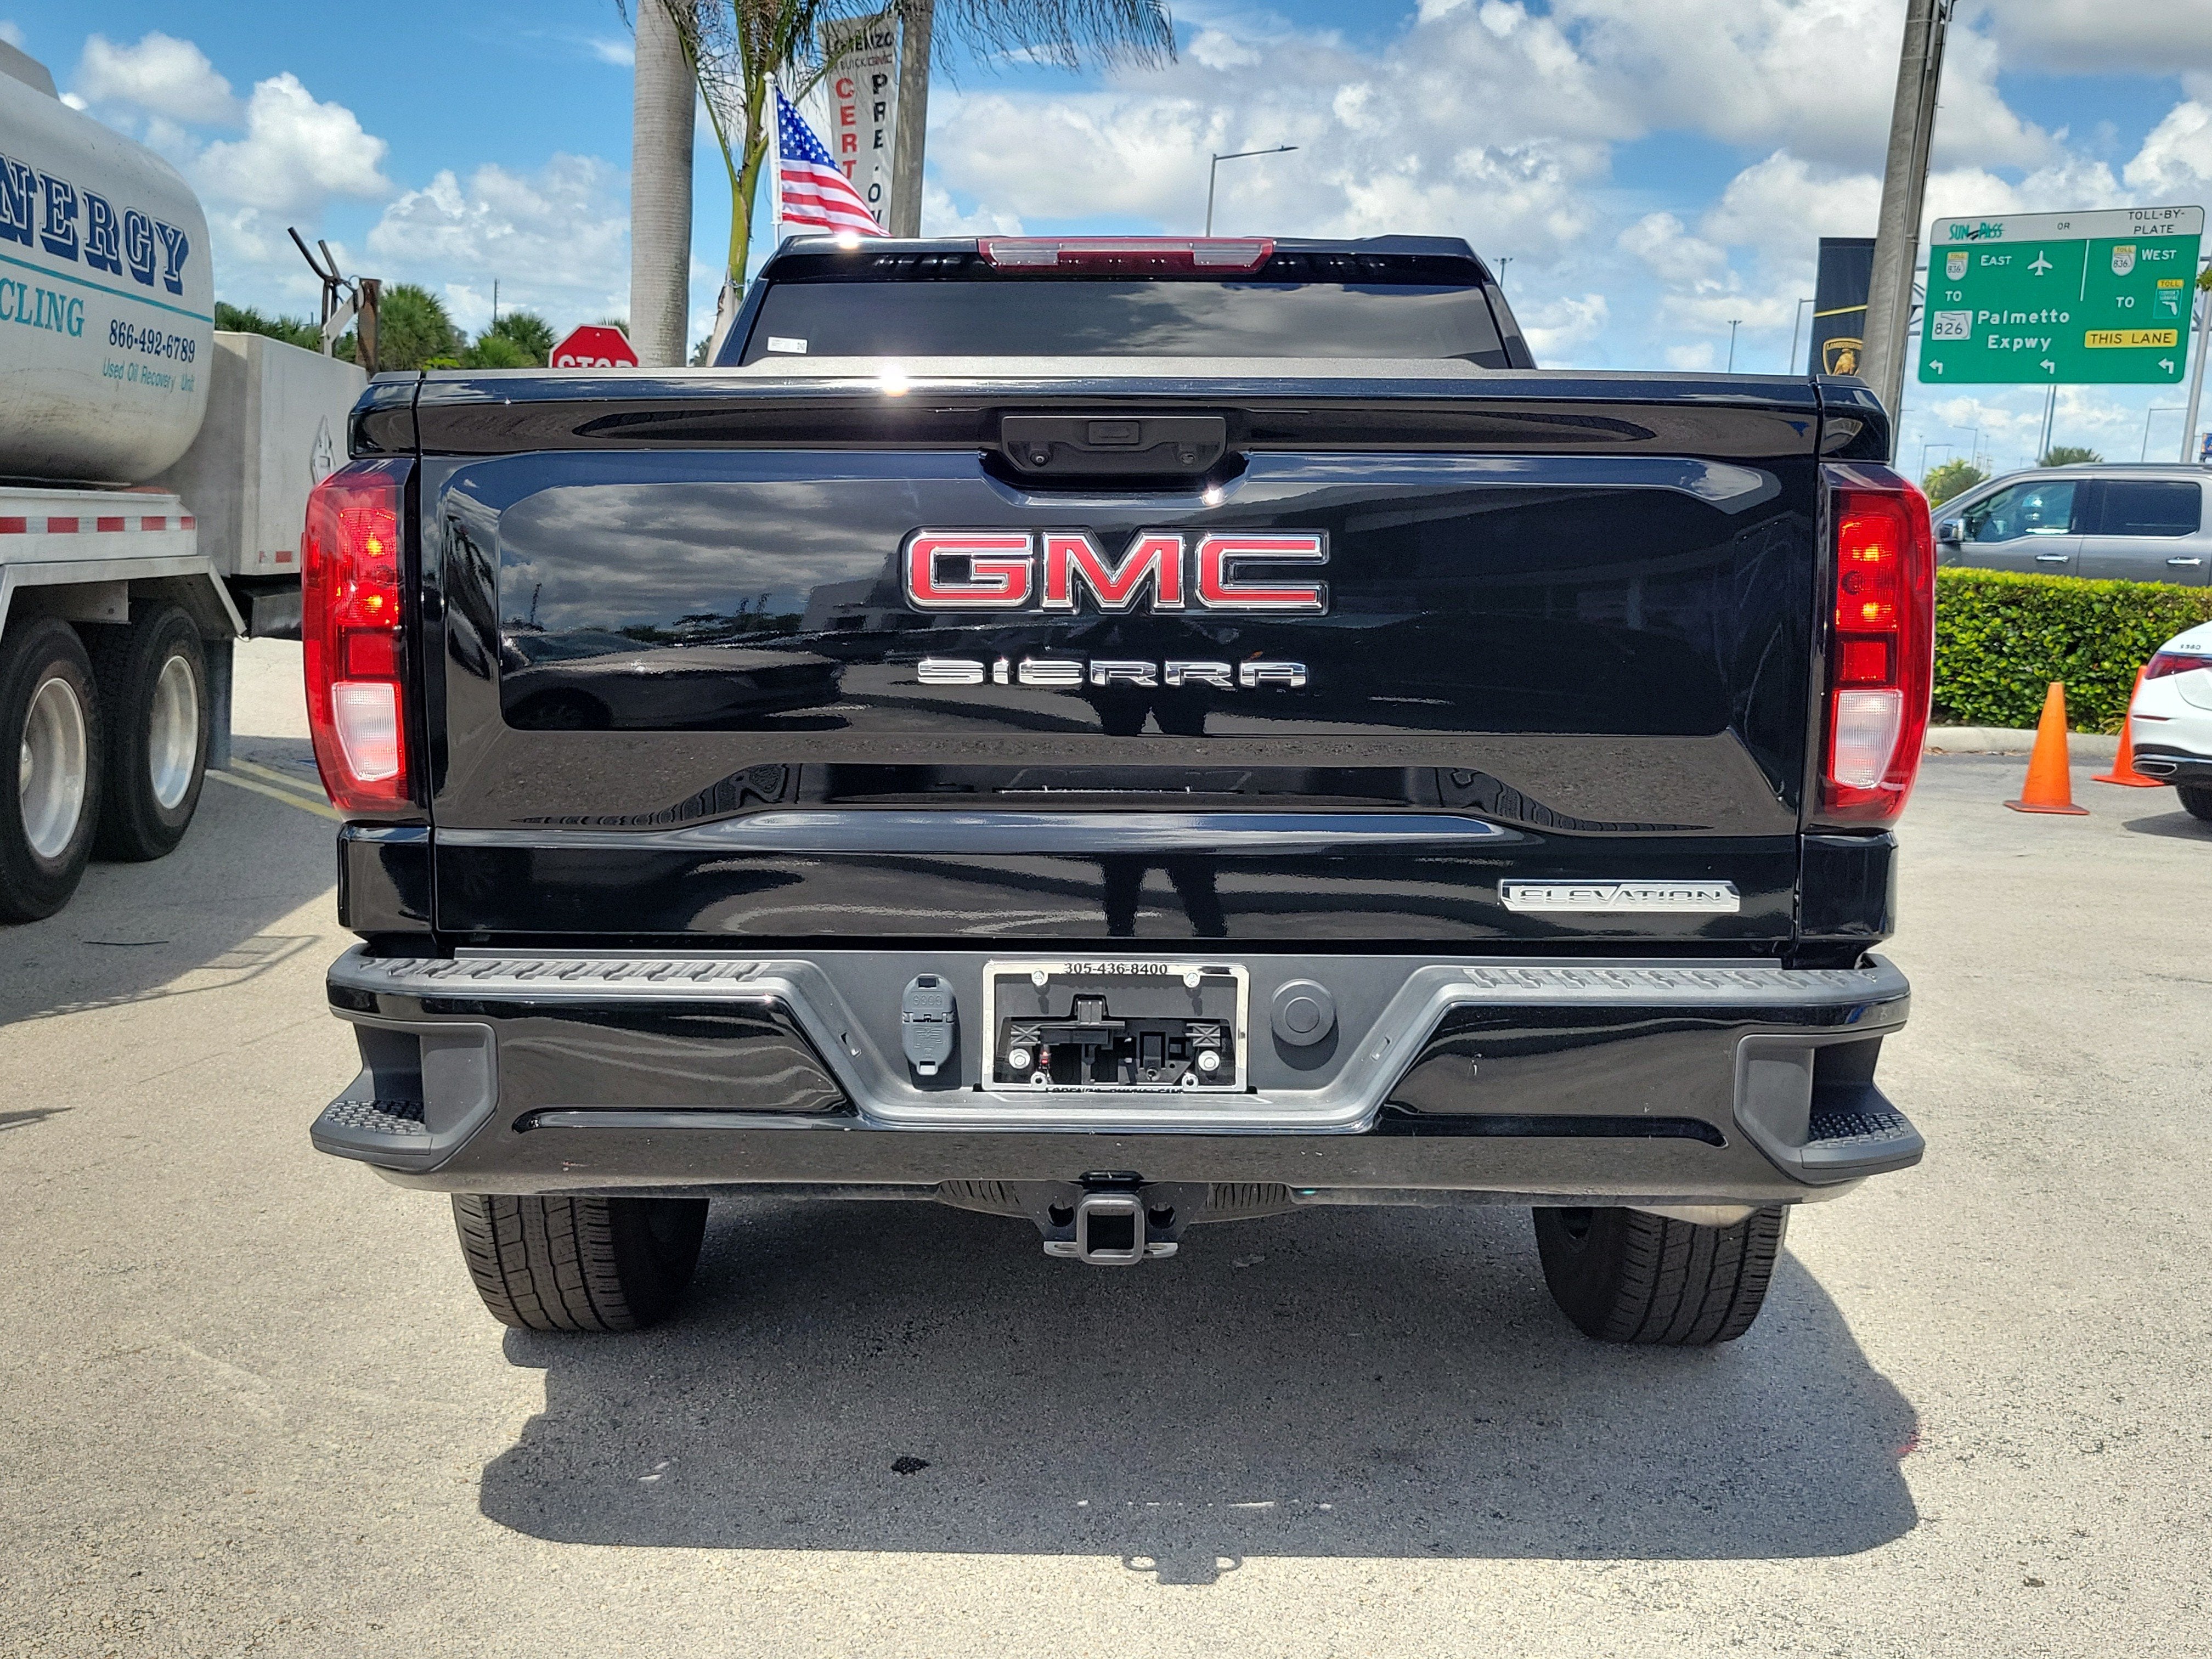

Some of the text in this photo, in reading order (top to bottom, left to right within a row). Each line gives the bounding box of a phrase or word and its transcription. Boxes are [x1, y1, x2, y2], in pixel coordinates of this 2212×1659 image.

[2057, 222, 2070, 230] OR
[2134, 224, 2174, 235] PLATE
[1980, 255, 2012, 266] EAST
[2142, 249, 2177, 261] WEST
[2113, 259, 2128, 268] 836
[1945, 290, 1962, 302] TO
[2116, 296, 2135, 308] TO
[0, 277, 85, 338] CLING
[1977, 309, 2070, 325] Palmetto
[1934, 323, 1963, 335] 826
[109, 319, 196, 363] 866-492-6789
[1988, 334, 2052, 352] Expwy
[2090, 332, 2172, 345] THIS LANE
[102, 357, 125, 380] Used
[127, 362, 139, 382] Oil
[902, 526, 1330, 616] GMC
[917, 659, 1307, 688] SIERRA
[1519, 887, 1722, 903] ELEVATION
[1064, 962, 1169, 975] 305-436-8400
